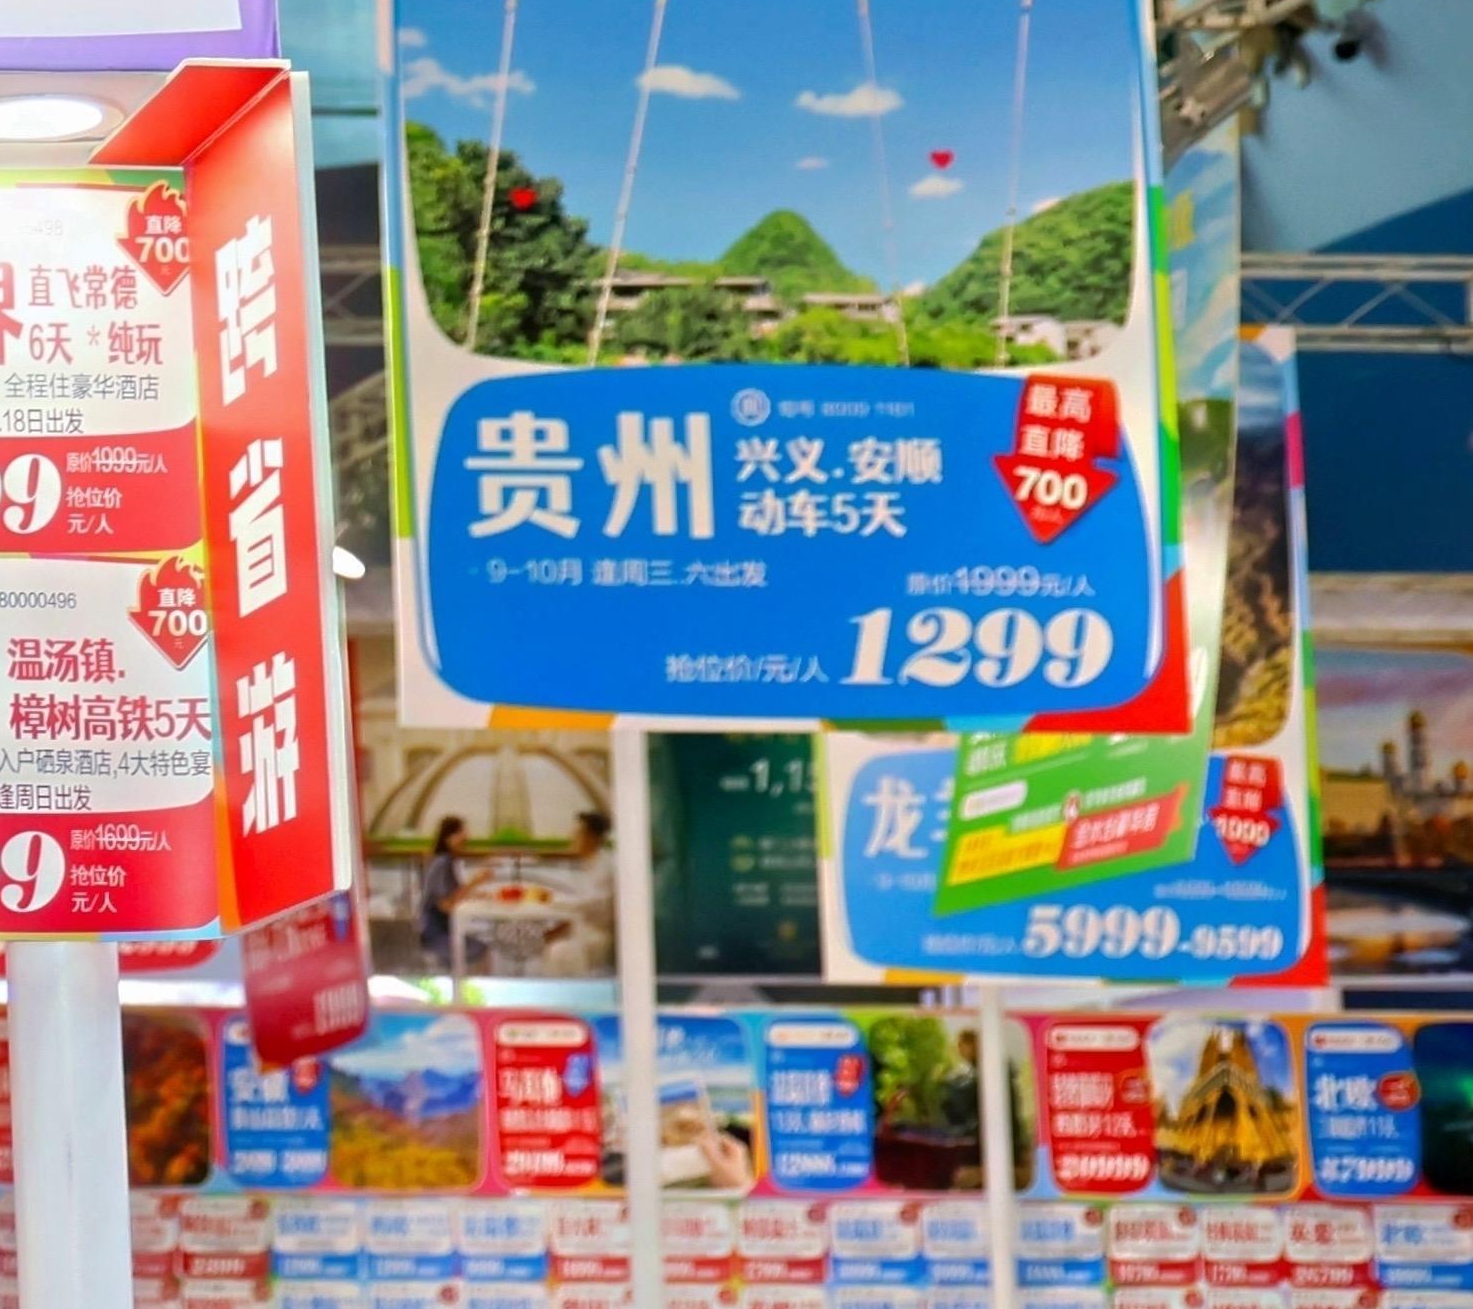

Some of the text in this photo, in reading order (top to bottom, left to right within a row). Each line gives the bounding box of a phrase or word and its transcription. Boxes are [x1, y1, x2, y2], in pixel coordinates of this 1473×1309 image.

[28, 266, 139, 310] 直飞常德
[1021, 424, 1083, 461] 直降
[465, 411, 713, 539] 贵州
[1015, 468, 1087, 508] 700
[216, 213, 299, 837] 跨省游
[739, 494, 905, 537] 动车5天
[842, 607, 1113, 688] 1299
[11, 693, 212, 741] 樟树高铁5天
